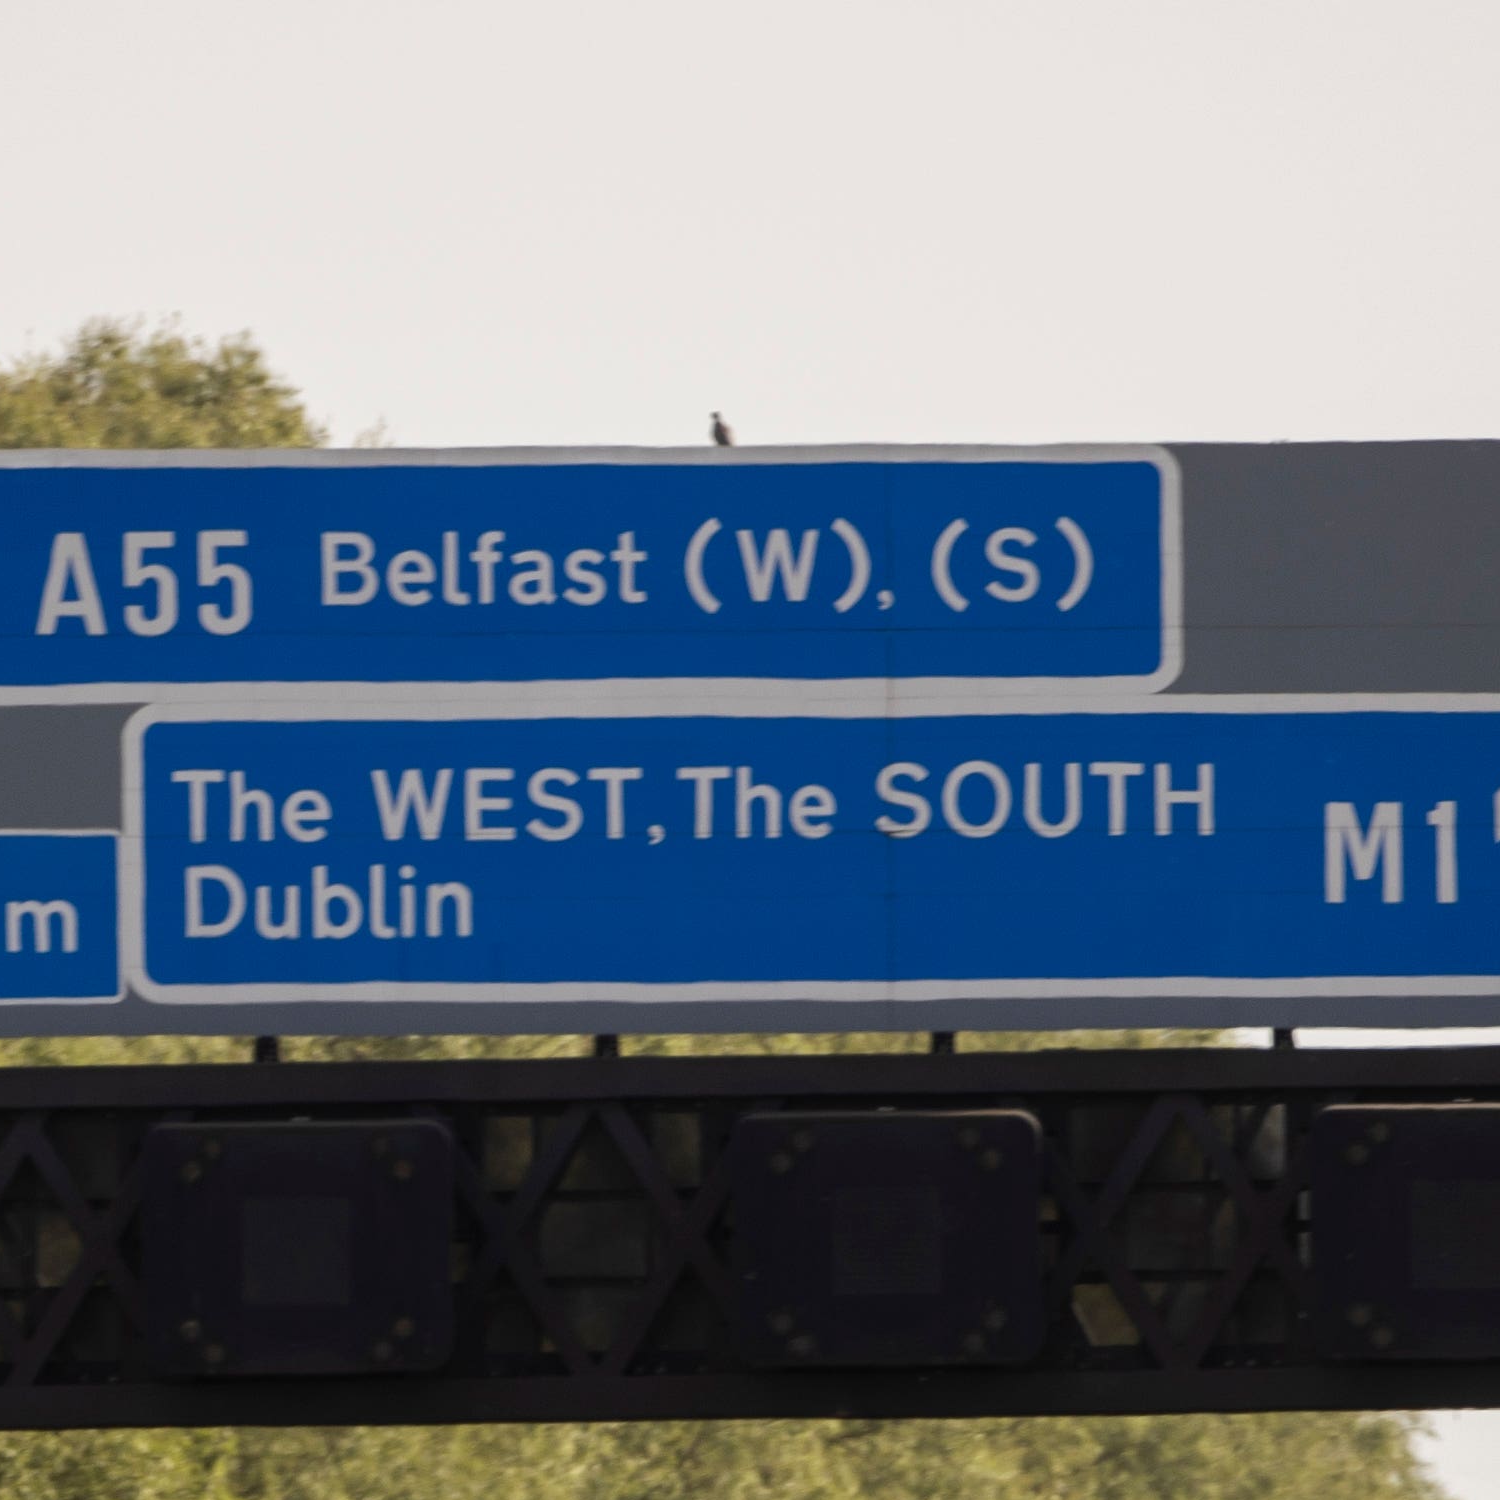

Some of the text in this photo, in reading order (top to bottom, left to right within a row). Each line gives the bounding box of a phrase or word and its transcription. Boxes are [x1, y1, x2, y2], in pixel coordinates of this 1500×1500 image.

[36, 517, 1094, 637] A55 Belfast (W), (S)
[171, 760, 1215, 845] The WEST, The SOUTH
[1324, 800, 1458, 904] M1
[184, 863, 473, 939] Dublin
